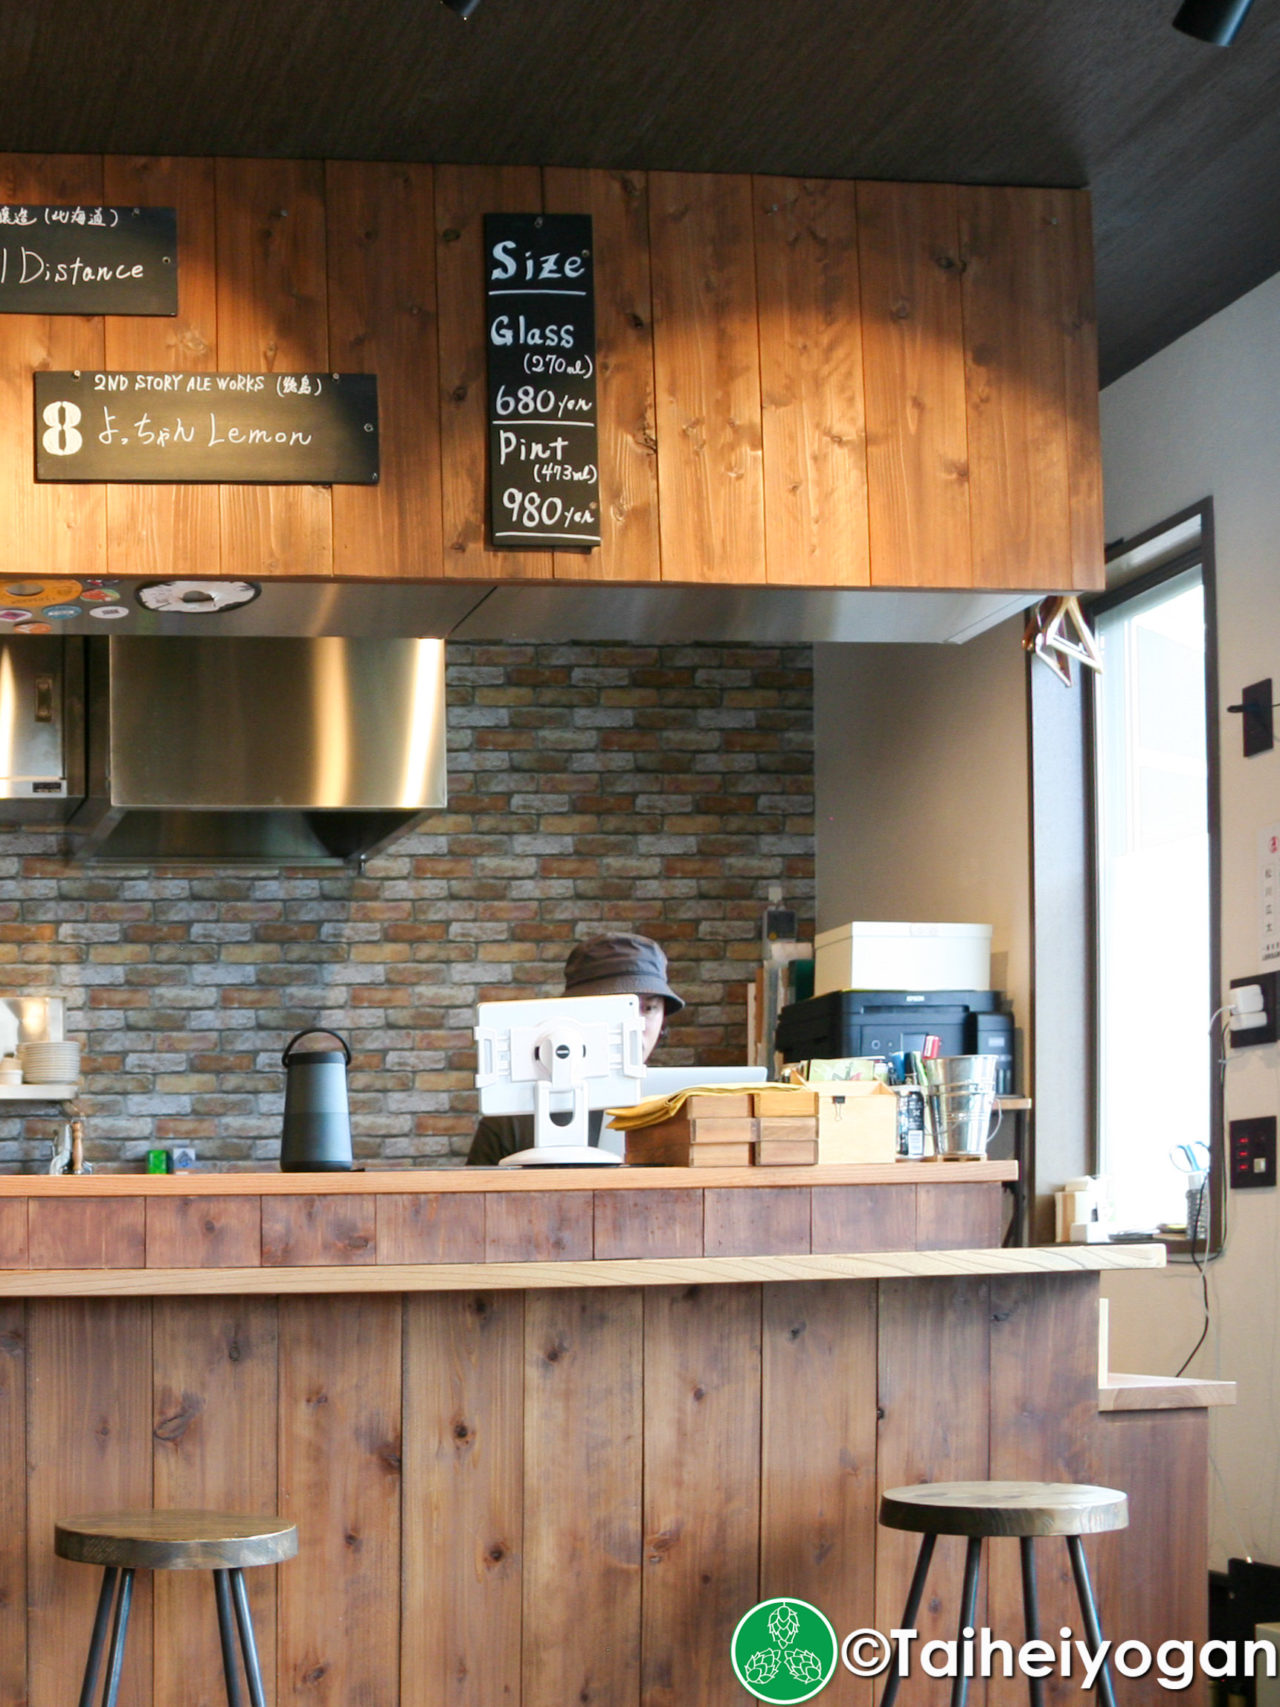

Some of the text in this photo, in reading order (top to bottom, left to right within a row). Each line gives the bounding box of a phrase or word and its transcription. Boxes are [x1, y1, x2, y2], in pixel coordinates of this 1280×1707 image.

[18, 247, 144, 285] Distance
[491, 240, 585, 281] Size
[490, 315, 574, 348] Glass
[93, 375, 128, 392] 2ND
[134, 374, 184, 392] STORY
[186, 376, 211, 392] ALE
[42, 401, 83, 456] 8
[208, 413, 312, 447] Lemon
[499, 429, 568, 465] Pint
